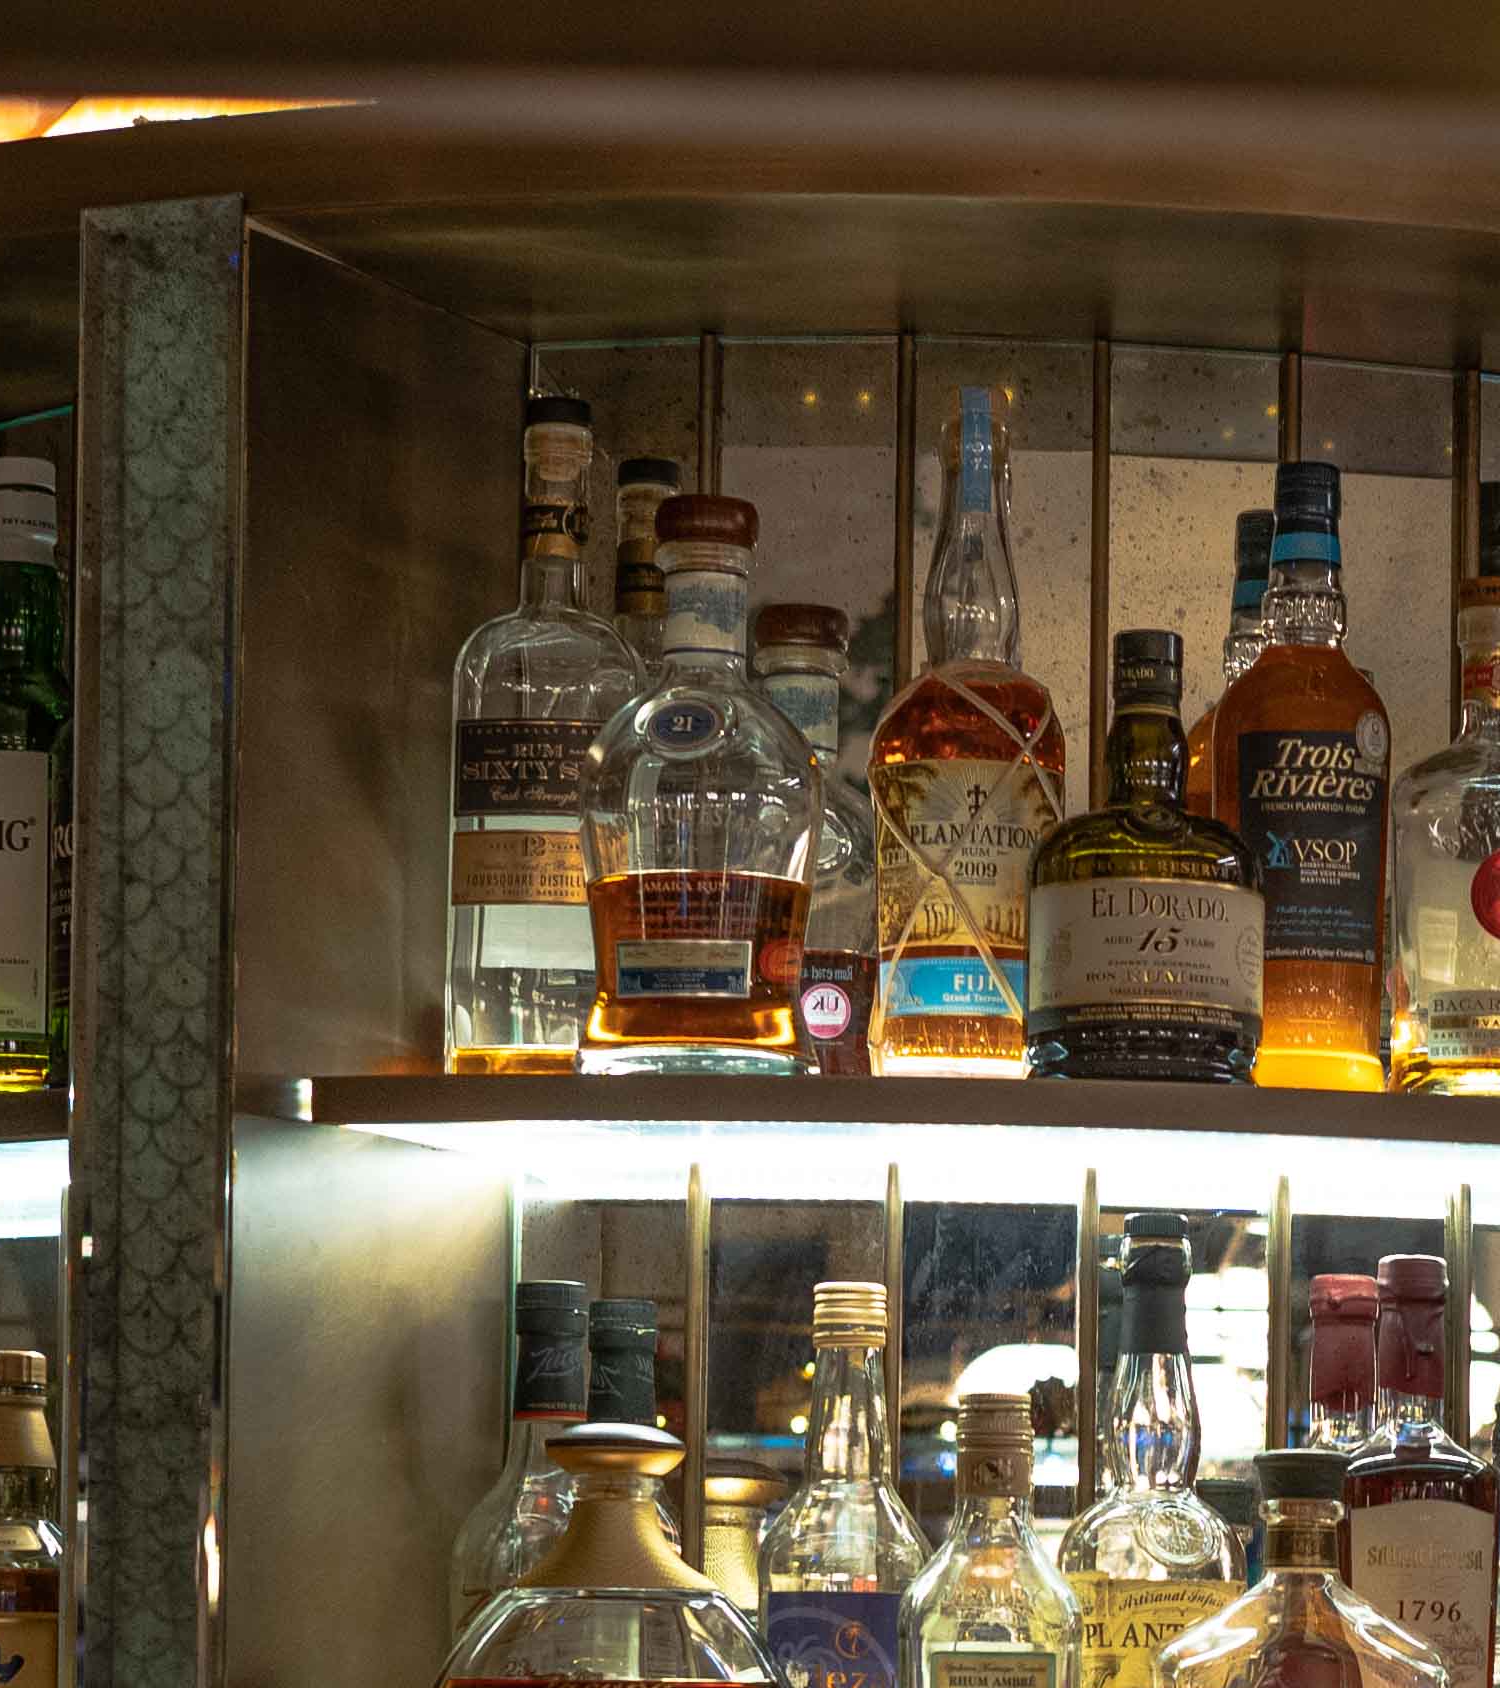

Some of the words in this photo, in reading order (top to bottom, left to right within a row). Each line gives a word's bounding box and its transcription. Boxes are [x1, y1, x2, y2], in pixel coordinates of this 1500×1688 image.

[515, 743, 564, 758] RUM
[1274, 737, 1356, 769] Trois
[463, 761, 554, 781] SIXTY
[1249, 768, 1377, 801] Rivières
[909, 823, 1039, 848] PLANTATION
[1292, 838, 1358, 864] VSOP
[954, 862, 998, 878] 2009
[1137, 927, 1184, 953] 15
[1397, 1599, 1462, 1623] 1796
[949, 1675, 988, 1688] RHUM
